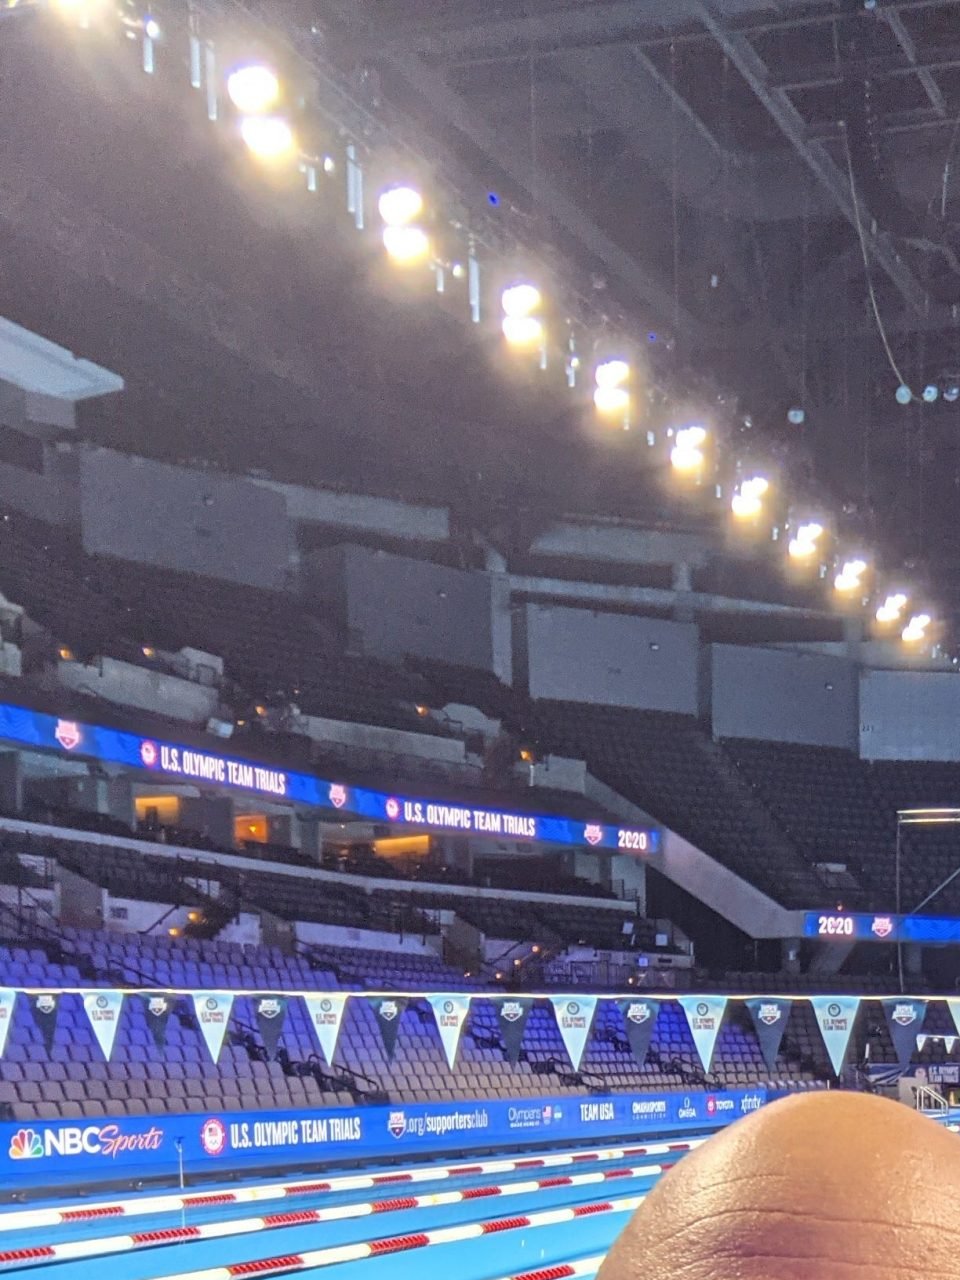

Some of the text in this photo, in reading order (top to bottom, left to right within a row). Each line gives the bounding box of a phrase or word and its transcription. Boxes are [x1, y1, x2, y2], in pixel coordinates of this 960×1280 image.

[160, 745, 286, 795] U.S. OLYMPIC TEAM TRIALS
[404, 801, 536, 837] U.S. OLYMPIC TEAM TRIALS
[617, 829, 647, 850] 2020
[818, 915, 853, 935] 2020
[580, 1102, 614, 1122] TEAM USA
[678, 1108, 697, 1119] OMEGA
[716, 1099, 734, 1112] TOYOTA
[741, 1093, 761, 1114] xfinity
[44, 1124, 163, 1160] NBC Sports
[230, 1116, 361, 1149] U.S. OLYMPIC TEAM TRIALS
